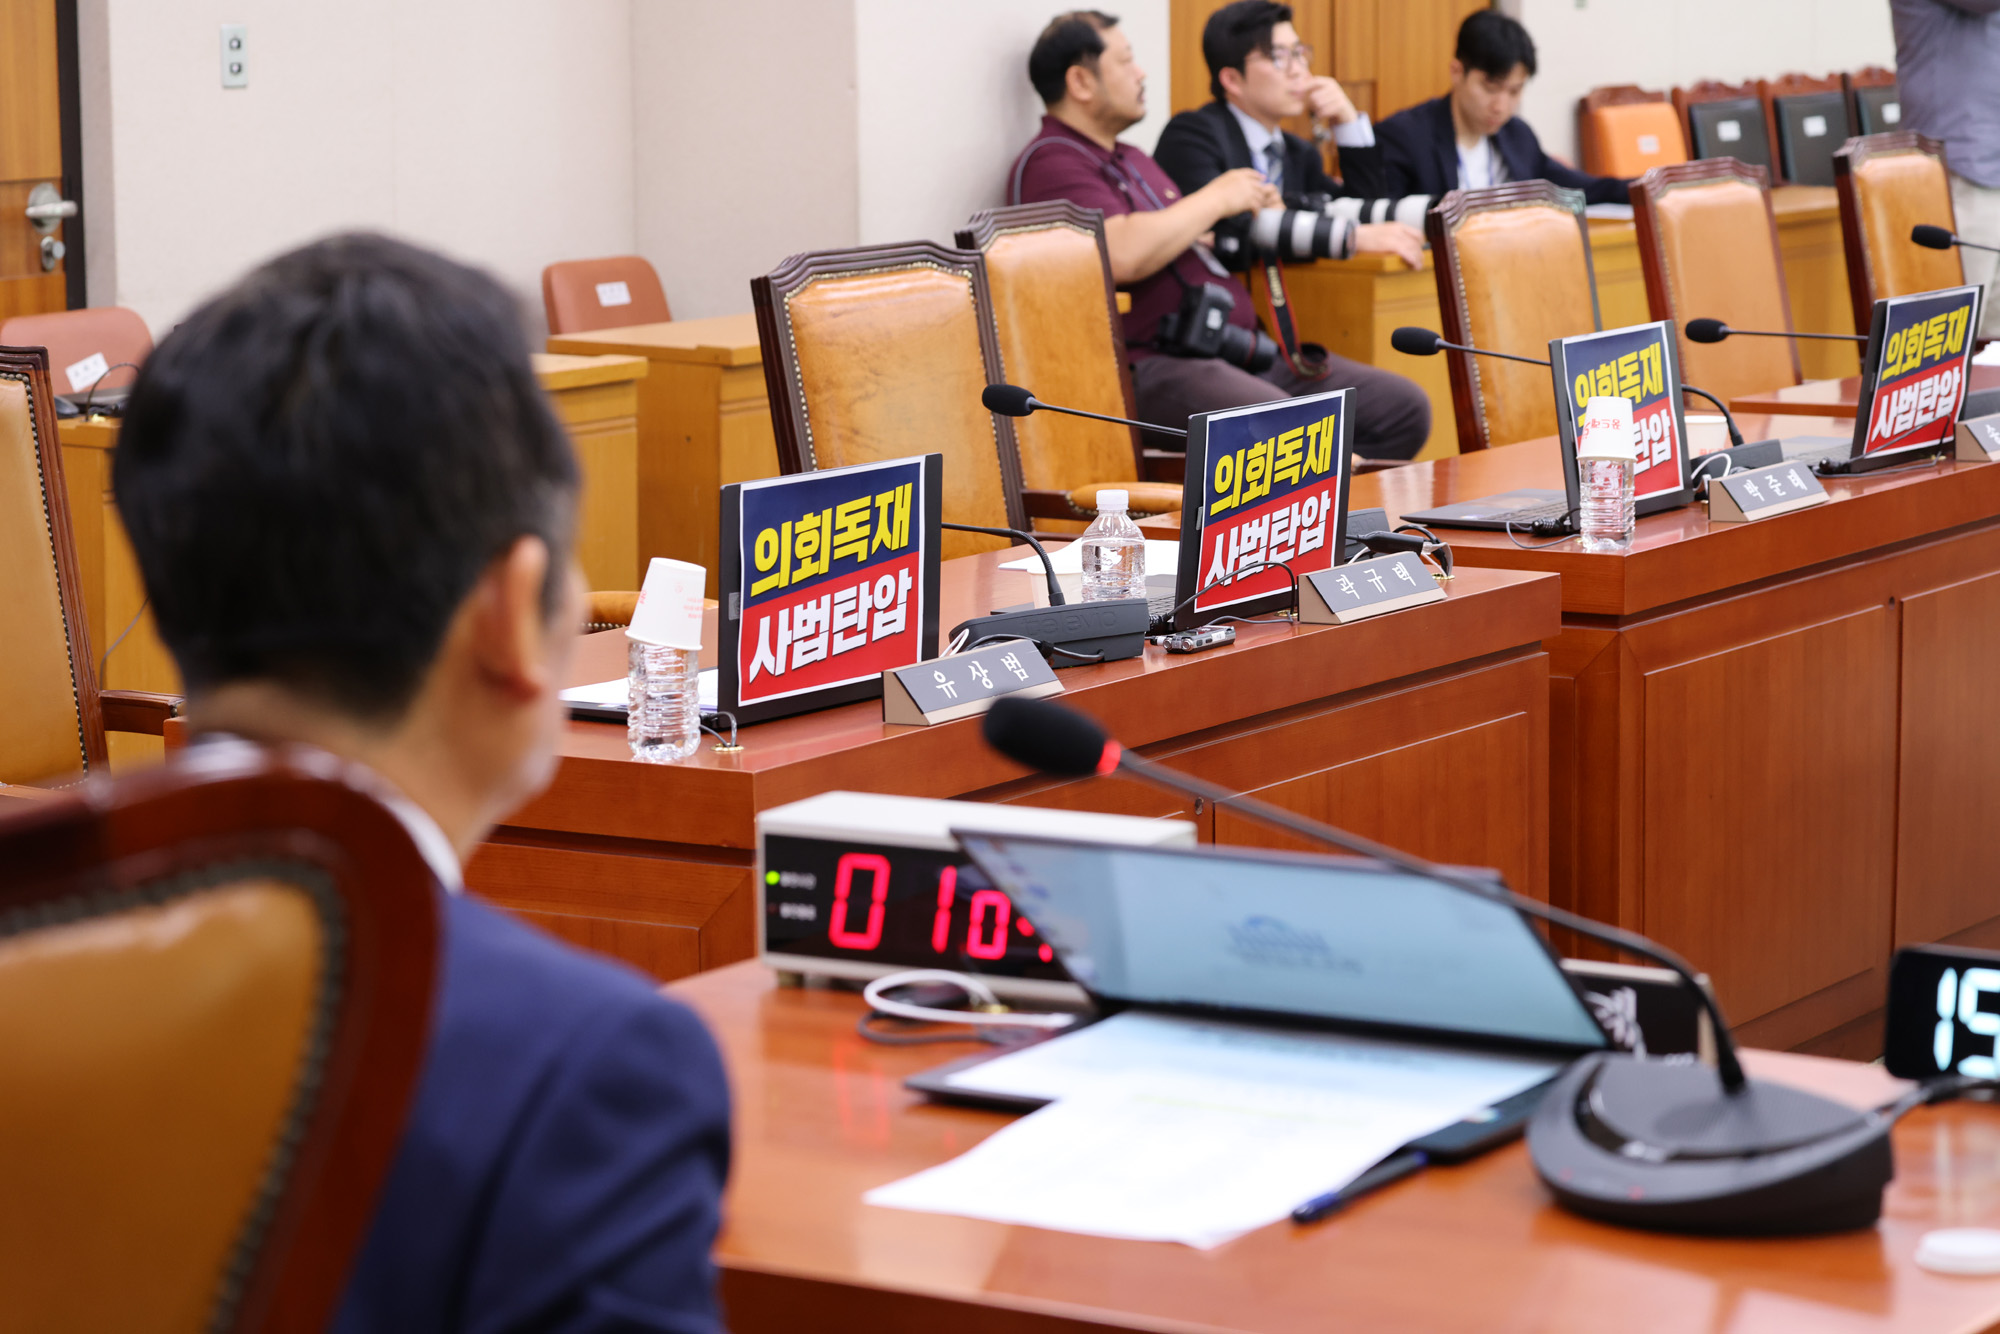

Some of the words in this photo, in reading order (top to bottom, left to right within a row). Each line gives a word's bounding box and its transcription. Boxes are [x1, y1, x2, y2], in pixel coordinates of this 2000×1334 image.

[1881, 305, 1970, 382] 의회독재
[1871, 366, 1961, 442] 사법탄압
[1210, 414, 1336, 516] 의회독재
[750, 482, 913, 598] 의회독재
[1204, 490, 1332, 588] 사법탄압
[1336, 561, 1416, 599] 곽규택
[749, 567, 913, 684] 사법탄압
[934, 651, 1028, 699] 유상범
